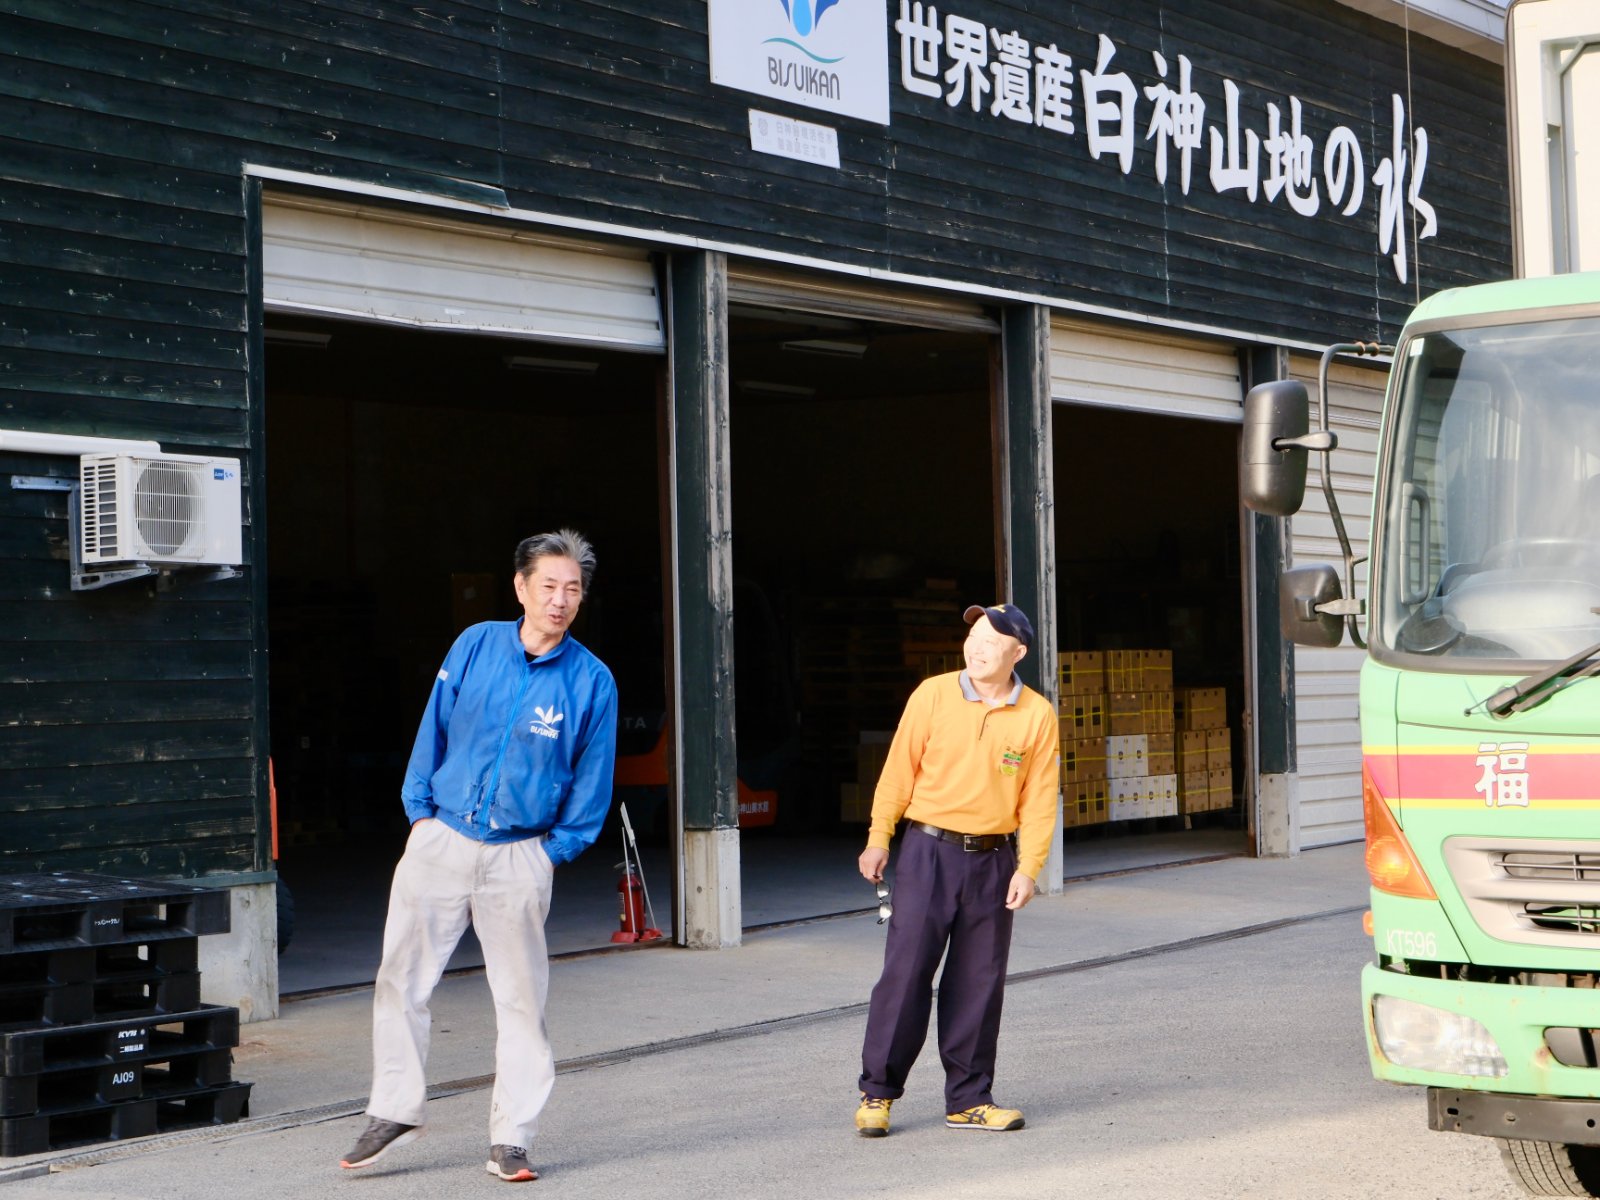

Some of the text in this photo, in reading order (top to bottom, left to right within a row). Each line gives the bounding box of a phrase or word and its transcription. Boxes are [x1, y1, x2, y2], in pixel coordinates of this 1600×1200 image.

[767, 56, 841, 101] BISUIKAN
[895, 0, 1438, 284] 世界遺産白神山地の水
[1474, 741, 1530, 808] 福
[1386, 927, 1437, 958] KT596
[112, 1071, 135, 1085] AJ09
